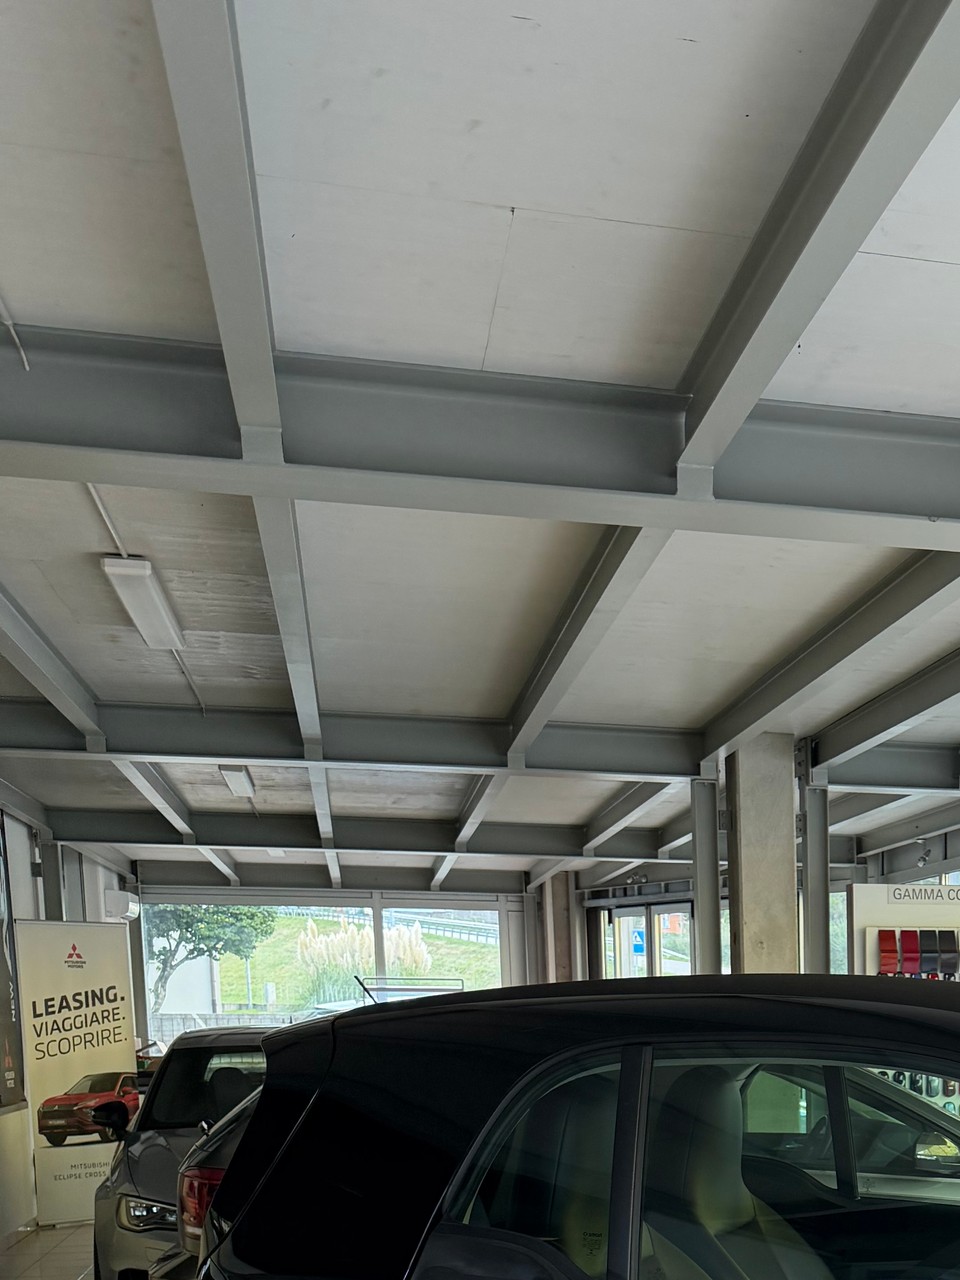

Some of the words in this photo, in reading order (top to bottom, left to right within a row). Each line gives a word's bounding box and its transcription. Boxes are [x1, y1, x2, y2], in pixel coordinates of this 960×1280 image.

[893, 887, 944, 901] GAMMA
[31, 985, 125, 1019] LEASING.
[32, 1006, 126, 1038] VIAGGIARE.
[35, 1025, 128, 1060] SCOPRIRE.
[54, 1173, 82, 1181] ECLIPSE
[84, 1171, 107, 1179] CROSS
[70, 1161, 110, 1170] MITSUBISHI
